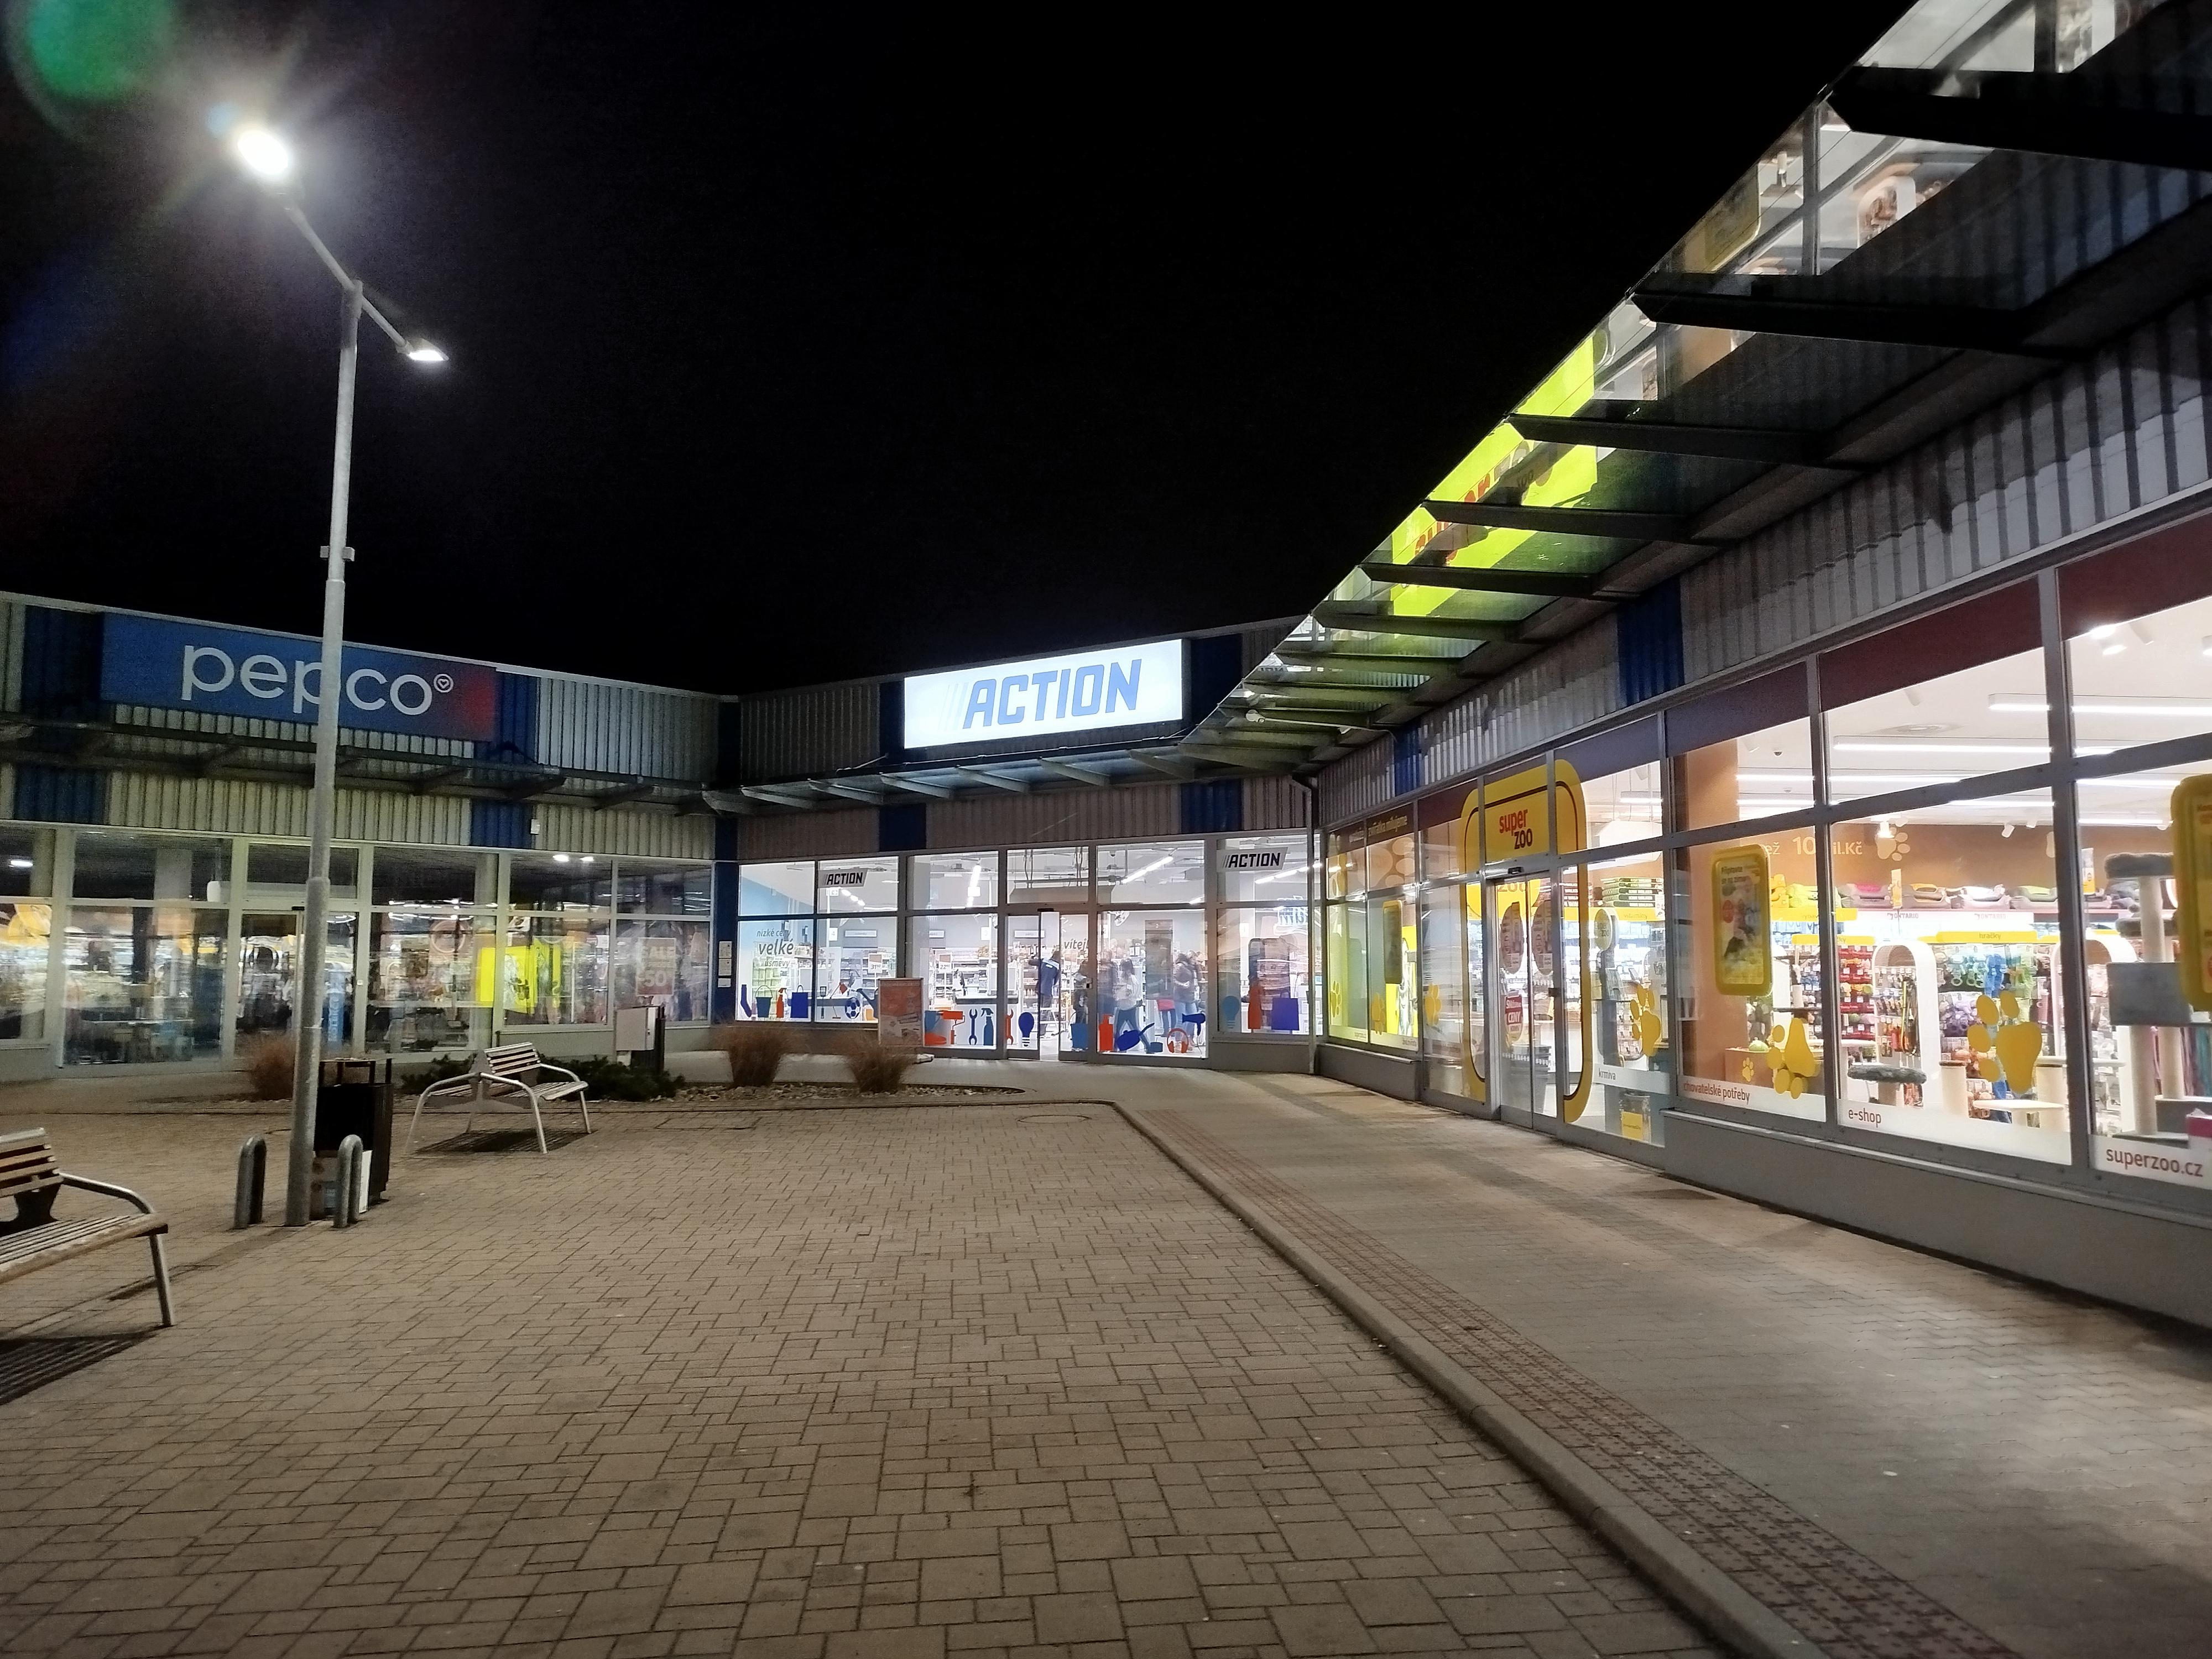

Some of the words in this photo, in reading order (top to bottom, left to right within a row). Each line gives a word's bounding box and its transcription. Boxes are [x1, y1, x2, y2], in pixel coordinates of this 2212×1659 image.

[181, 645, 433, 716] pepco
[963, 659, 1142, 729] ACTION
[1499, 809, 1528, 837] super
[1766, 841, 1781, 855] ež
[1792, 836, 1816, 855] 10
[1833, 841, 1863, 855] il.Kč
[1228, 852, 1281, 868] ACTION
[827, 872, 863, 885] ACTION
[759, 938, 794, 956] velké
[1064, 938, 1088, 951] vítej
[1599, 1067, 1616, 1081] krmiva
[1683, 1081, 1721, 1097] chovatelské
[1723, 1086, 1750, 1105] potřeby
[1849, 1108, 1881, 1128] e-shop
[2106, 1149, 2203, 1177] superzoo.cz
